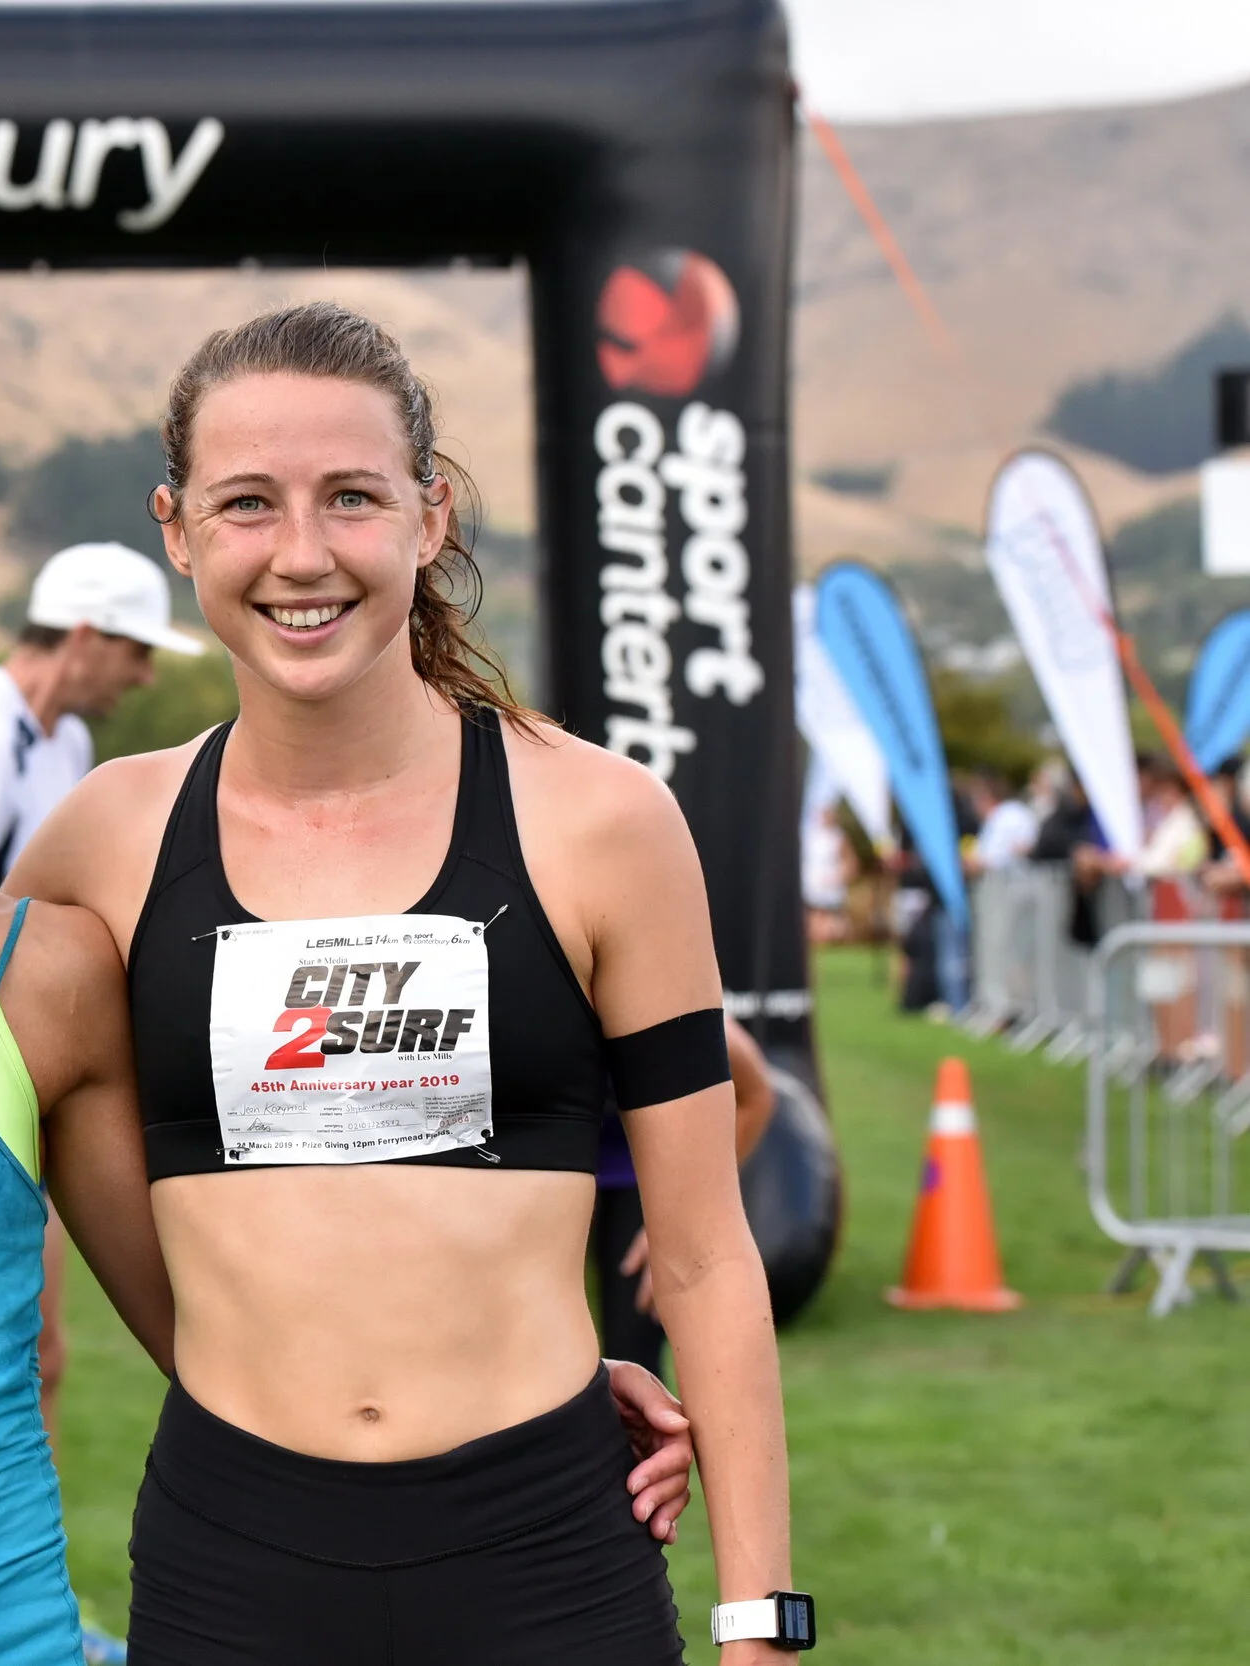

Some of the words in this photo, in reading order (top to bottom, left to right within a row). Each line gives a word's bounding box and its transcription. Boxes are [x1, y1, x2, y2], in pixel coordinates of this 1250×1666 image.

[659, 401, 765, 706] sport
[413, 937, 450, 945] canterbury
[451, 934, 470, 945] 6km
[299, 958, 315, 966] Star
[324, 957, 348, 965] Media
[284, 961, 422, 1009] CITY
[398, 1053, 415, 1061] with
[417, 1053, 430, 1061] Les
[433, 1052, 453, 1060] Mills
[251, 1081, 286, 1093] 45th
[289, 1079, 376, 1092] Anniversary
[381, 1079, 415, 1091] year
[420, 1075, 460, 1087] 2019
[249, 1141, 272, 1149] March
[275, 1141, 293, 1149] 2019
[302, 1141, 322, 1149] Prize
[324, 1141, 350, 1151] Giving
[352, 1140, 376, 1149] 12pm
[378, 1133, 423, 1146] Ferrymead
